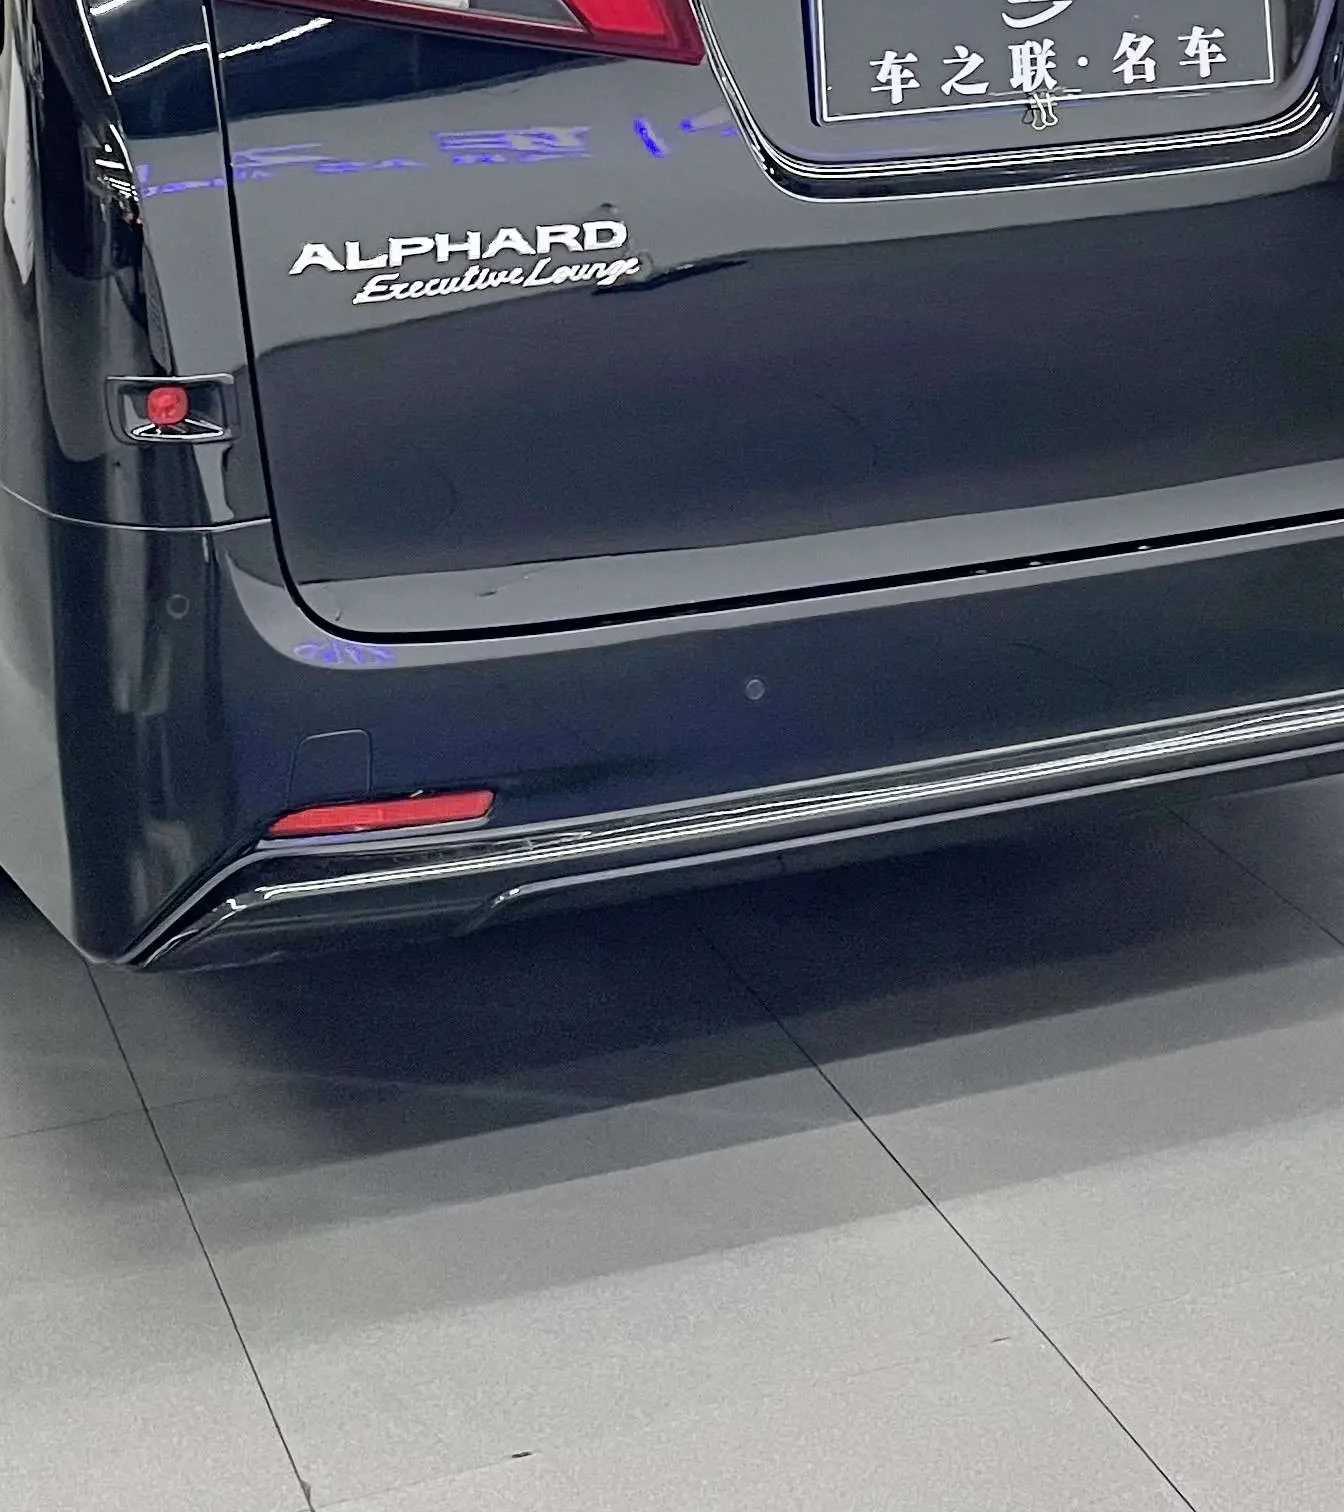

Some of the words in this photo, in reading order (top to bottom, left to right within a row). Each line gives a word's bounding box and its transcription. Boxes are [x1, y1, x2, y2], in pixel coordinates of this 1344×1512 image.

[288, 219, 628, 276] ALPHARD
[351, 264, 524, 306] Executive
[521, 256, 641, 287] Lounge
